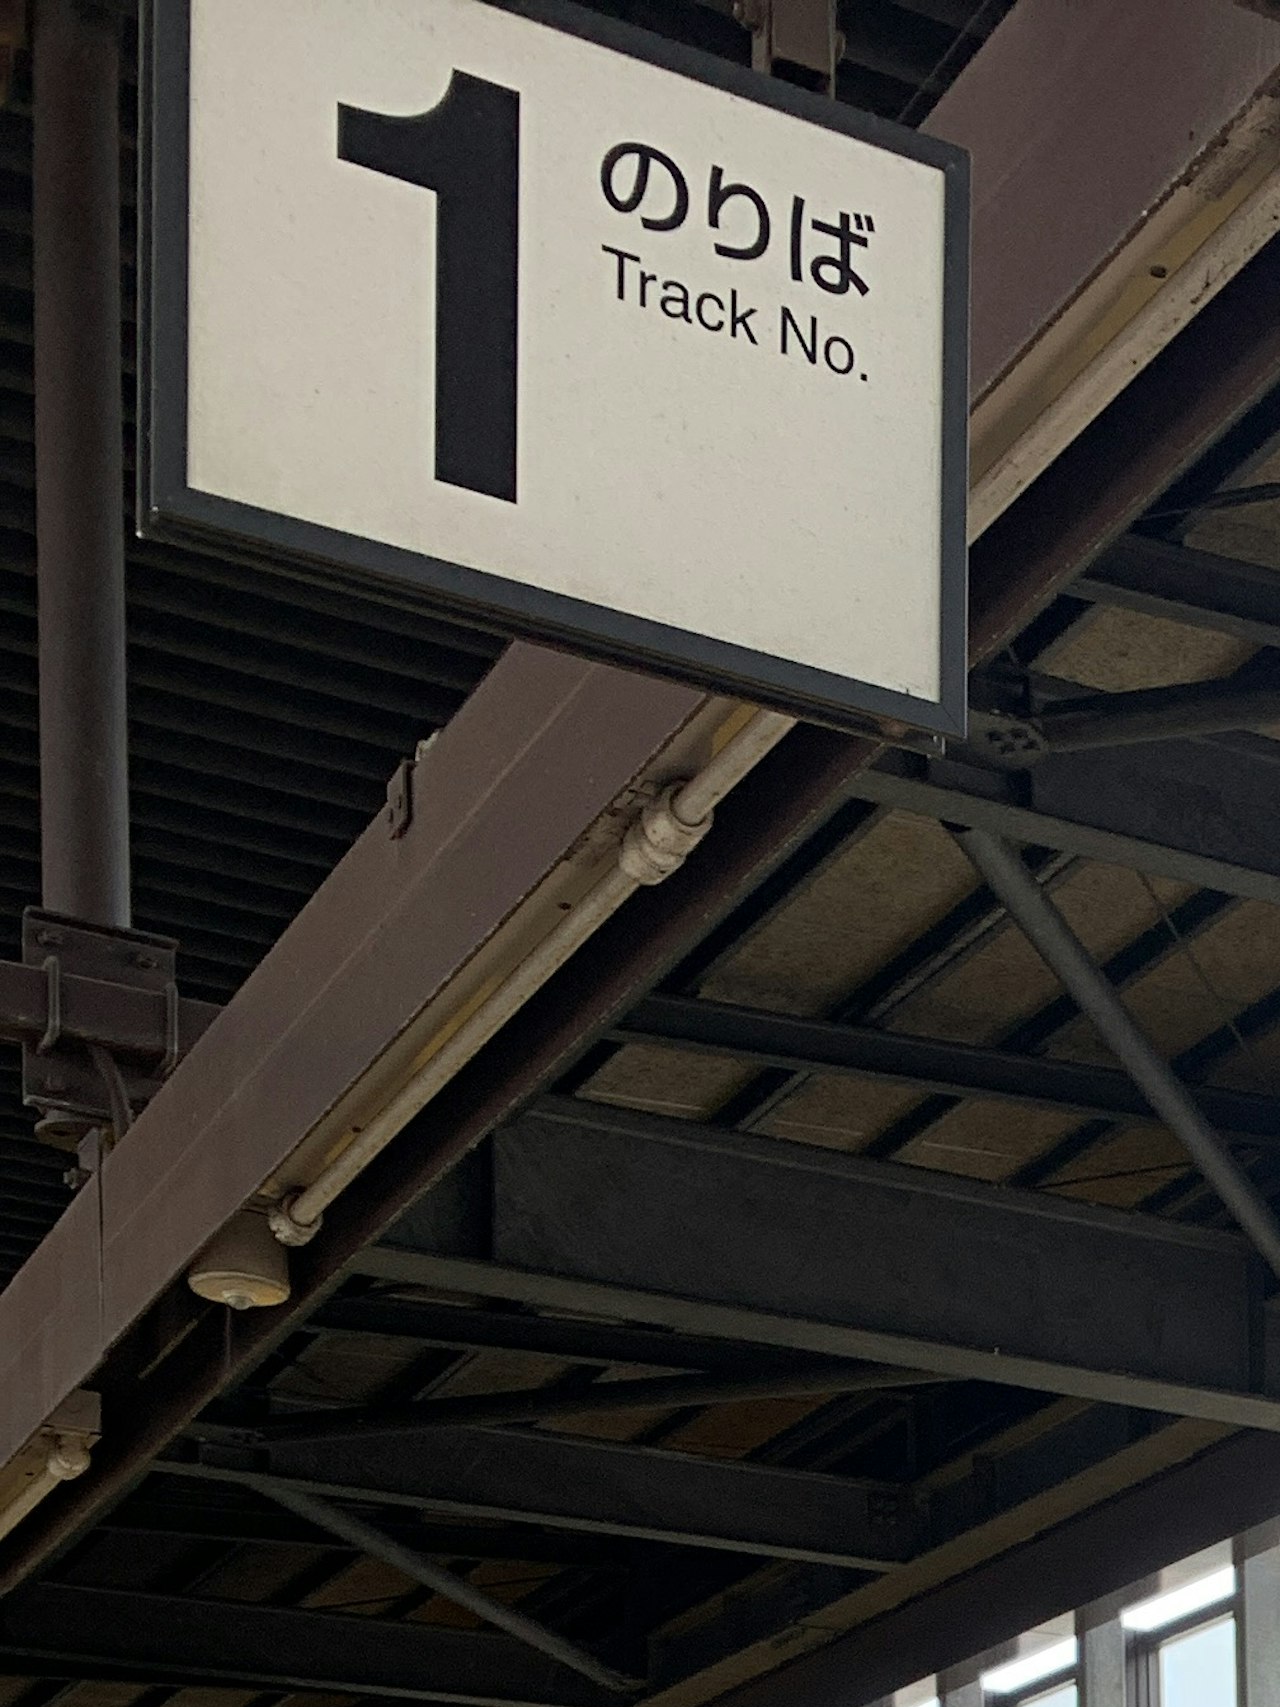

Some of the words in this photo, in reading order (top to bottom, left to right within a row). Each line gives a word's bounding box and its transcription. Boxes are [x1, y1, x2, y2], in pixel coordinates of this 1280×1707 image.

[337, 68, 520, 505] 1
[599, 140, 876, 299] のりば
[601, 245, 759, 346] Track
[779, 306, 870, 383] No.
